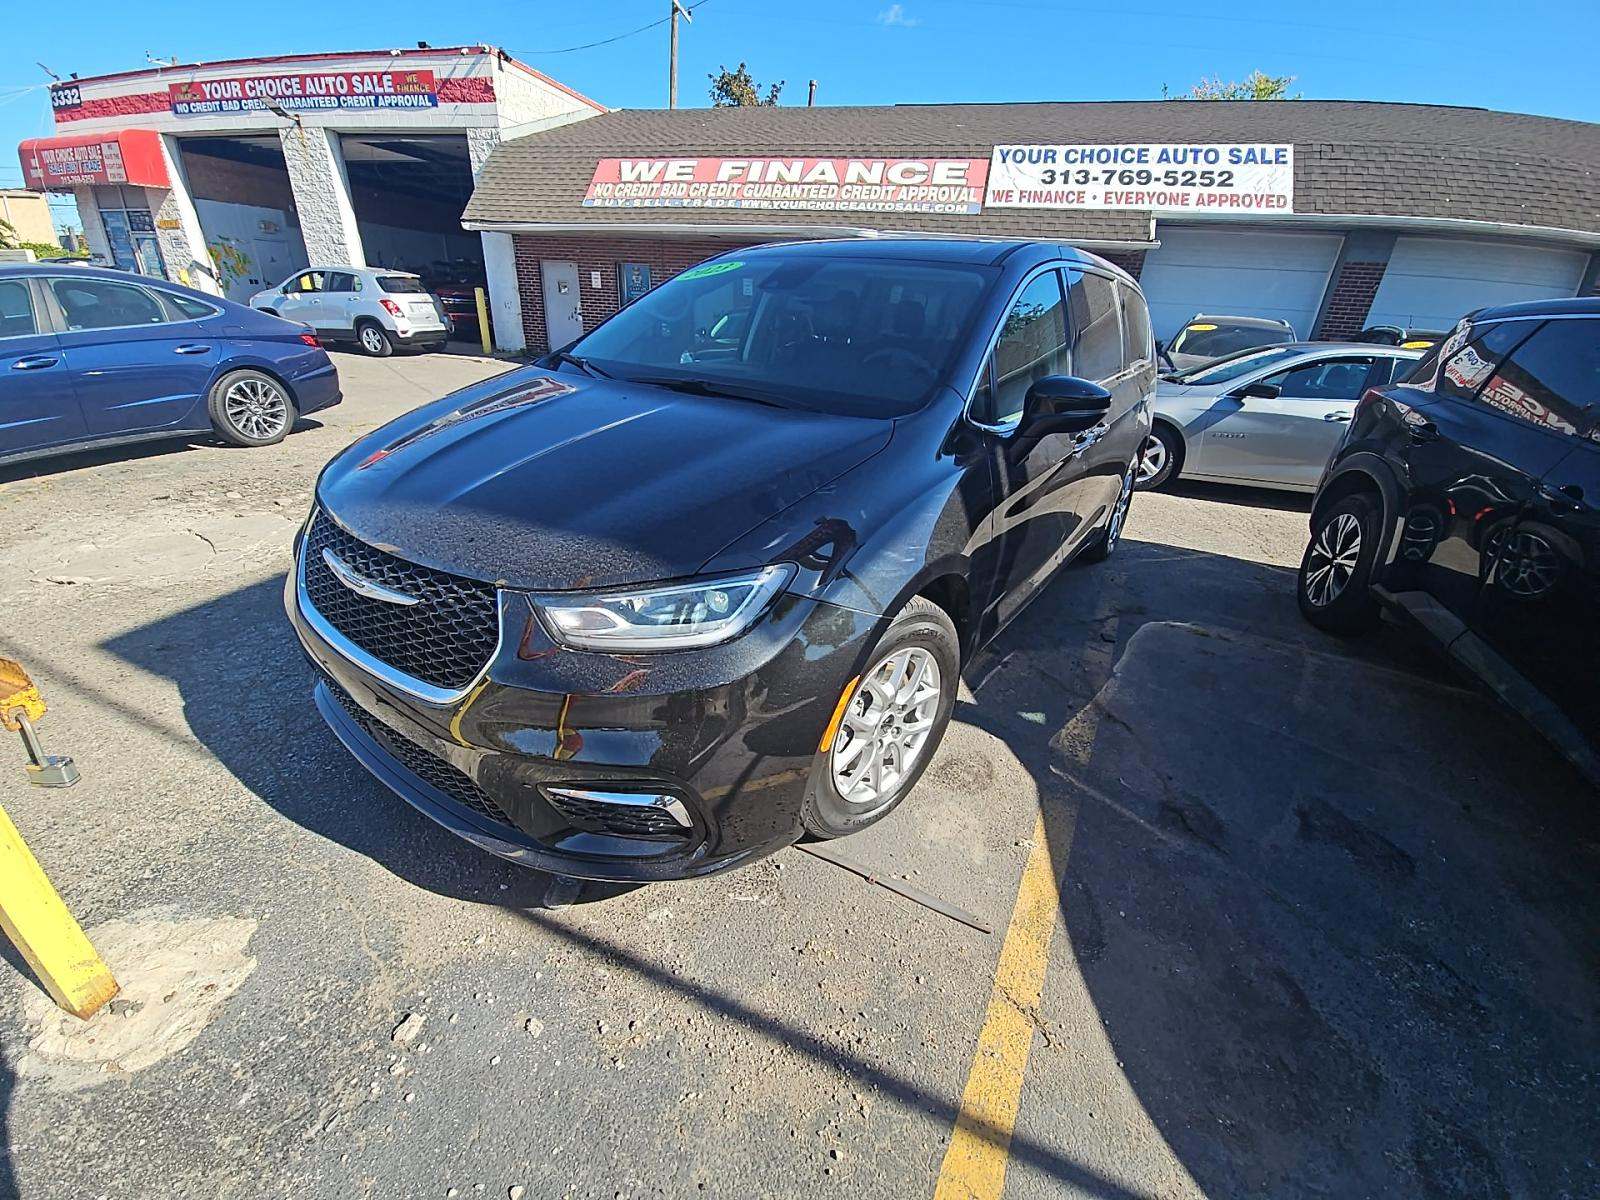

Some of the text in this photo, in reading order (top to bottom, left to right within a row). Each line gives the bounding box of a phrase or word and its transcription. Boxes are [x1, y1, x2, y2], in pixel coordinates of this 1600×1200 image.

[201, 74, 394, 99] YOUR CHOICE AUTO SALE
[405, 73, 417, 83] WE
[52, 88, 80, 107] 3332
[396, 83, 430, 93] FINANCE
[176, 103, 190, 114] NO
[189, 101, 220, 113] CREDIT
[221, 100, 240, 112] BAD
[276, 96, 338, 109] GUARANTEED
[340, 95, 376, 108] CREDIT
[378, 94, 432, 107] APPROVAL
[999, 147, 1288, 165] YOUR CHOICE AUTO SALE
[619, 160, 970, 186] WE FINANCE
[1040, 169, 1234, 188] 313-769-5252
[593, 182, 977, 202] NO CREDIT BAD CREDIT GUARANTEED CREDIT APPROVAL
[992, 190, 1287, 209] WE FINANCE EVERYONE APPROVED
[740, 199, 969, 213] WWW.YOURCHOICEAUTOSALE.COM
